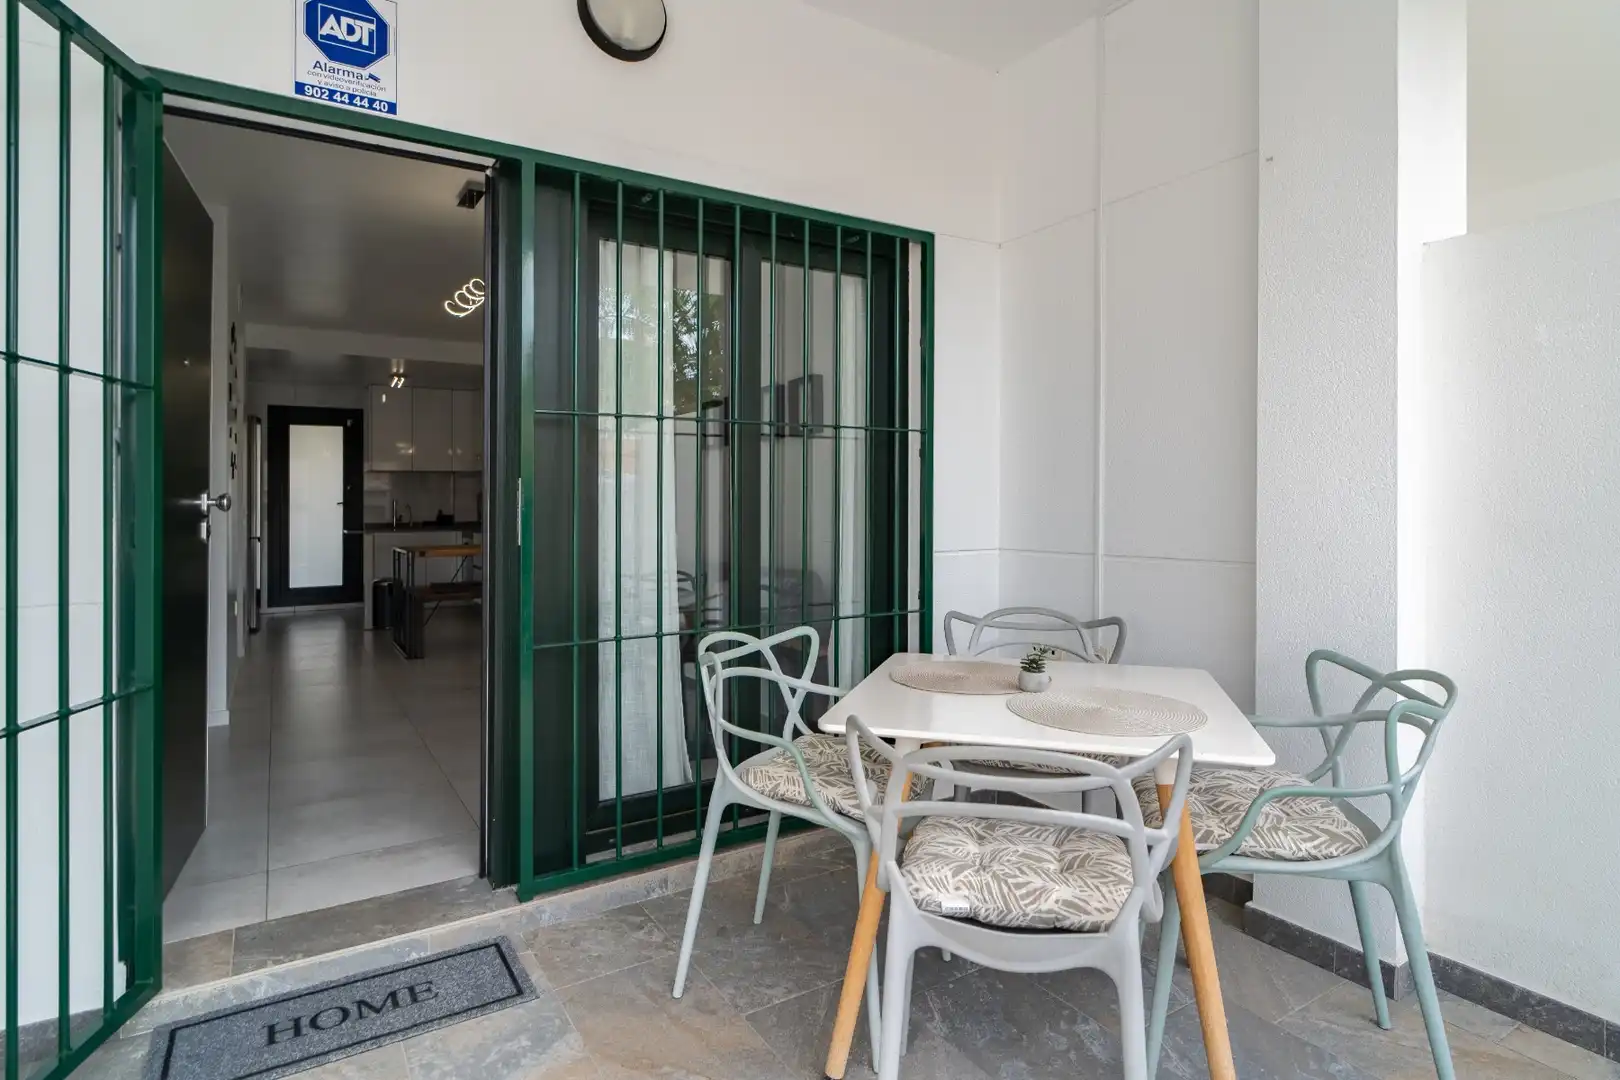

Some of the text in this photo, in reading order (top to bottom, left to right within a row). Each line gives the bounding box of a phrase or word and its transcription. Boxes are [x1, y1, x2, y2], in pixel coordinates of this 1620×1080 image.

[320, 14, 376, 46] ADT
[307, 70, 322, 78] con
[313, 60, 363, 80] Alarma
[323, 81, 345, 90] aviso
[304, 85, 388, 112] 902 44 44 40
[262, 981, 439, 1046] HOME
